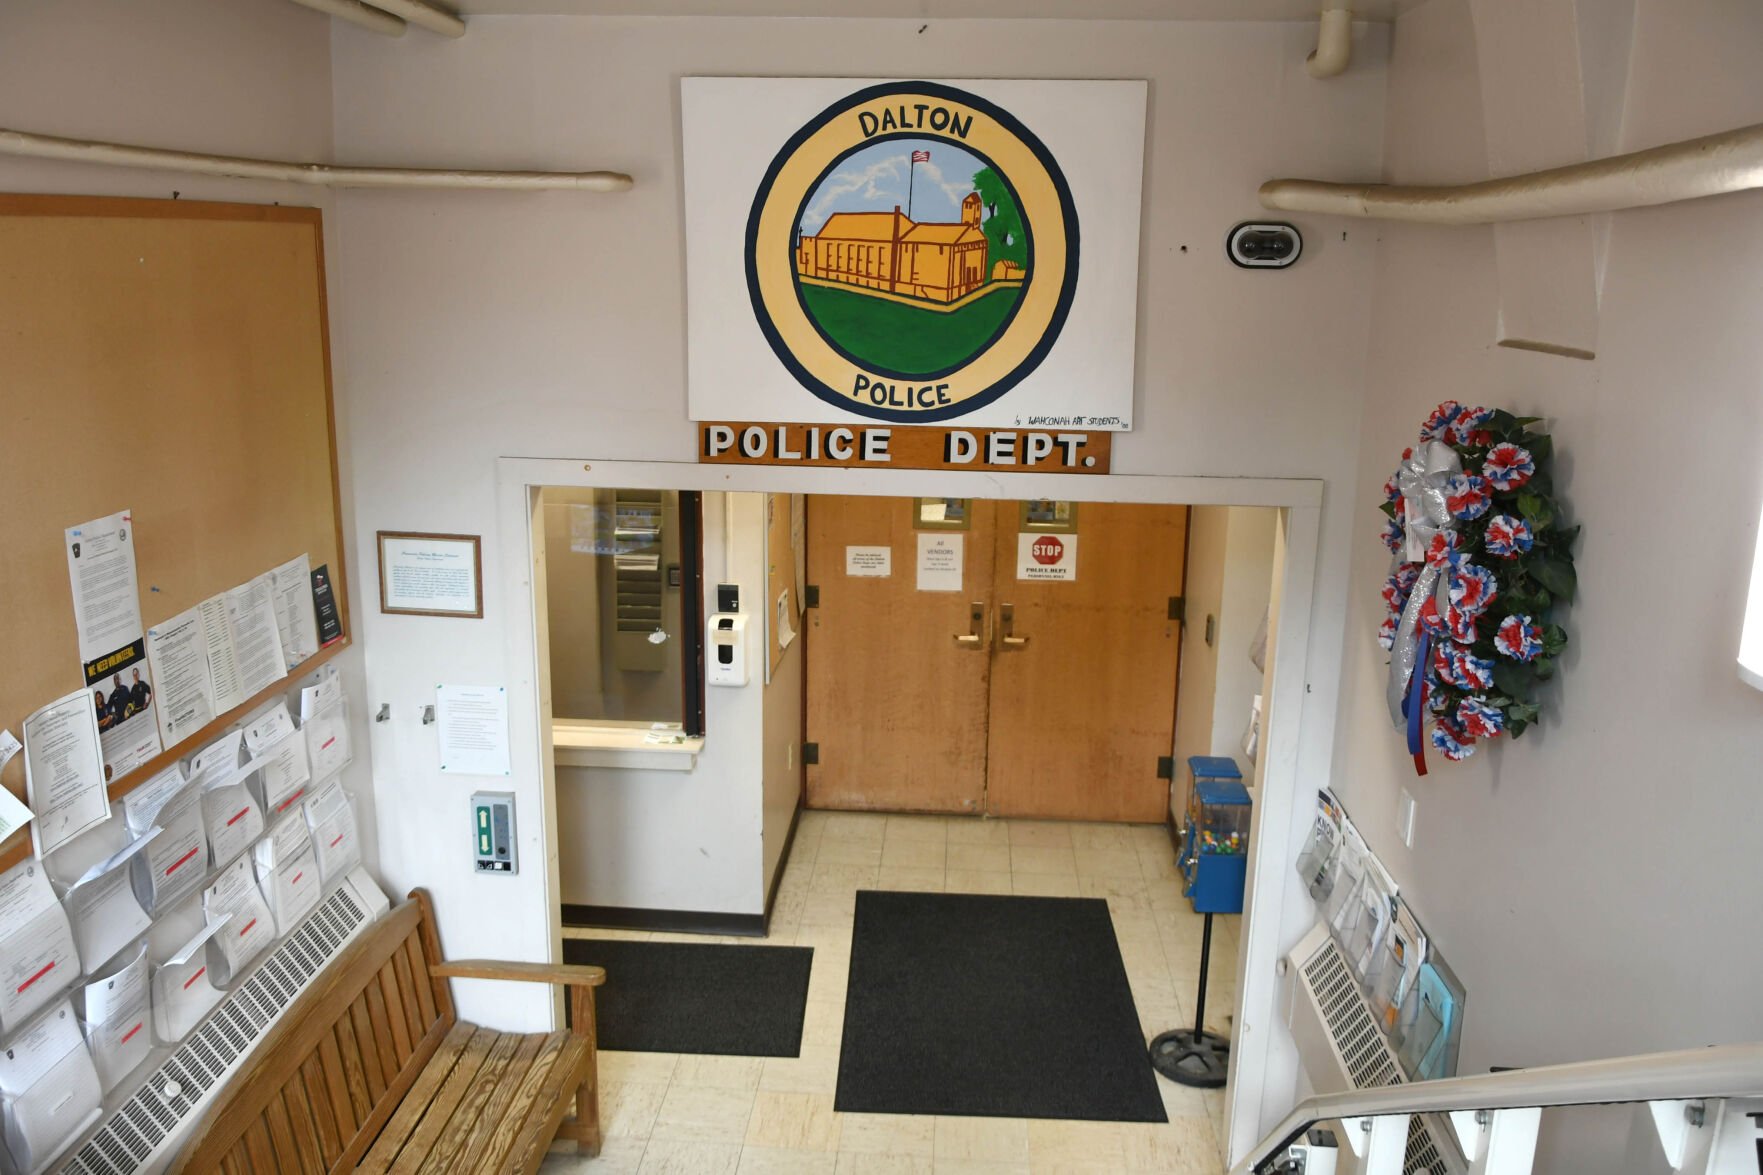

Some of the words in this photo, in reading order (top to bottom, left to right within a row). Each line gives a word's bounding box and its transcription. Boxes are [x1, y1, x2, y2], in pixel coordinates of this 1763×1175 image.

[858, 104, 974, 139] DALTON
[853, 374, 952, 408] POLICE
[1072, 415, 1086, 426] ART
[706, 425, 892, 462] POLICE
[946, 430, 1096, 467] DEPT.
[1033, 544, 1062, 557] STOP
